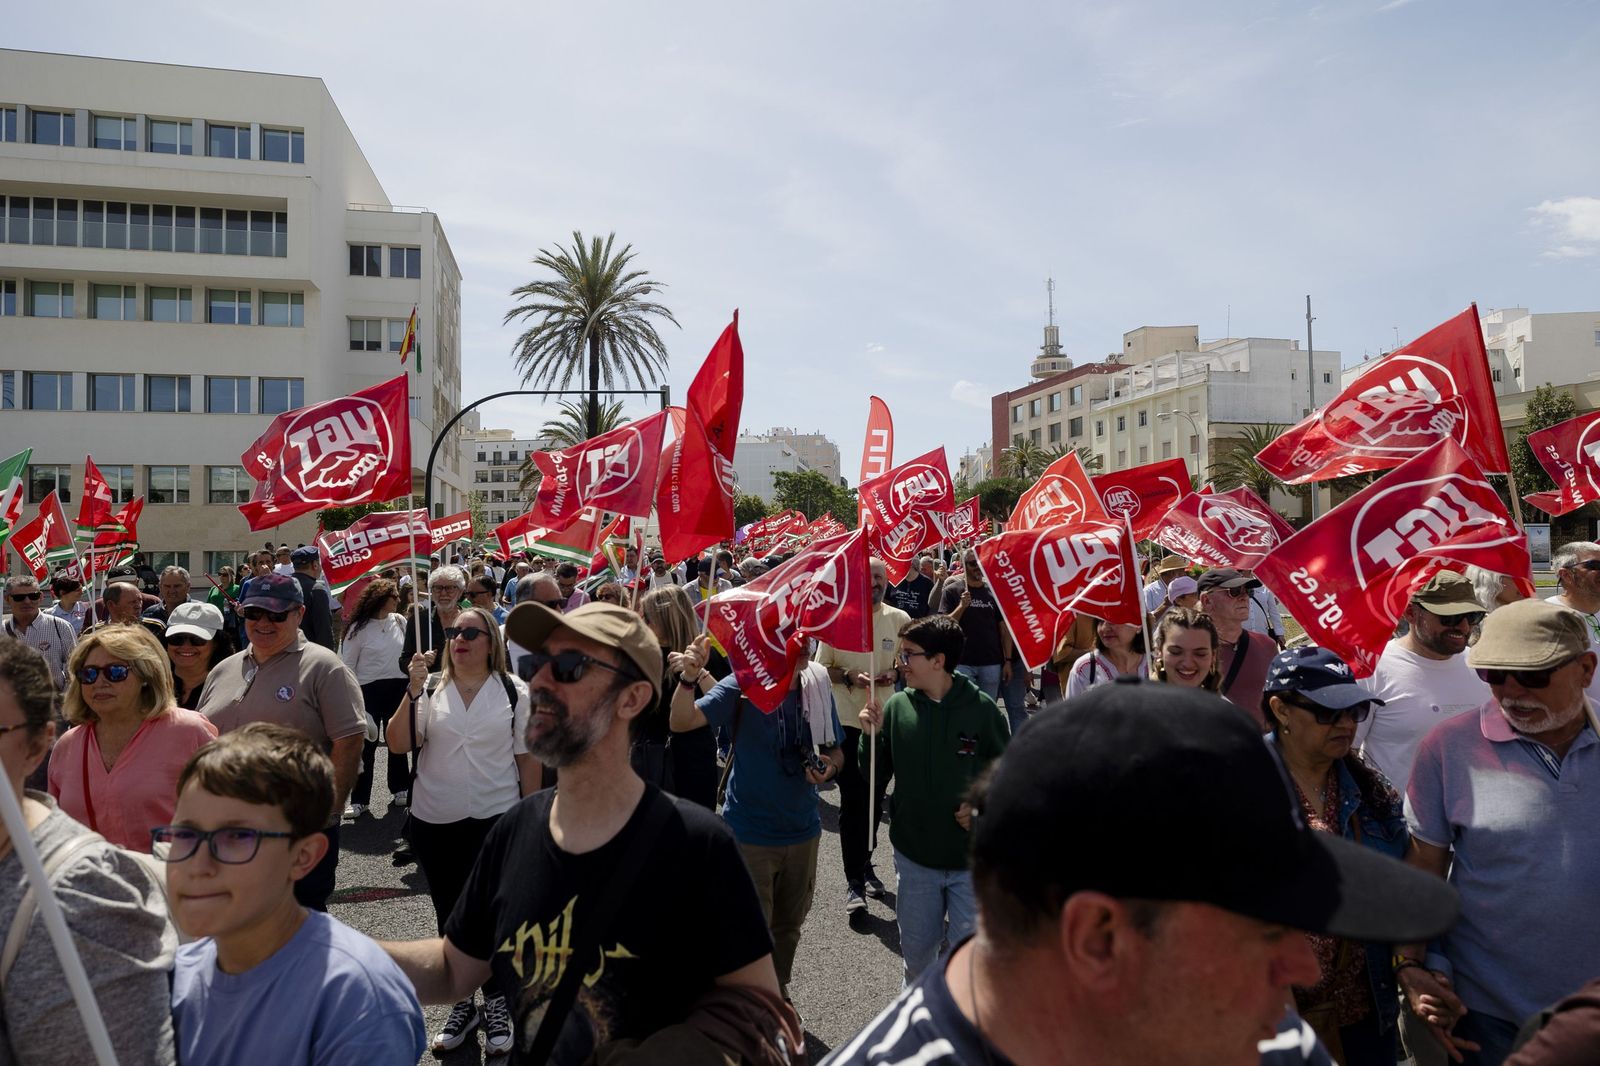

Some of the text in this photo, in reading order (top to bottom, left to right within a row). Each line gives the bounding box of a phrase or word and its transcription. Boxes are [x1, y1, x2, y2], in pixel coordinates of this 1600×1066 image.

[1025, 479, 1075, 529] UGT
[1107, 490, 1136, 509] UGT
[885, 514, 920, 547] UGT
[1043, 528, 1121, 587] UGT
[995, 550, 1046, 643] www.ugt.es
